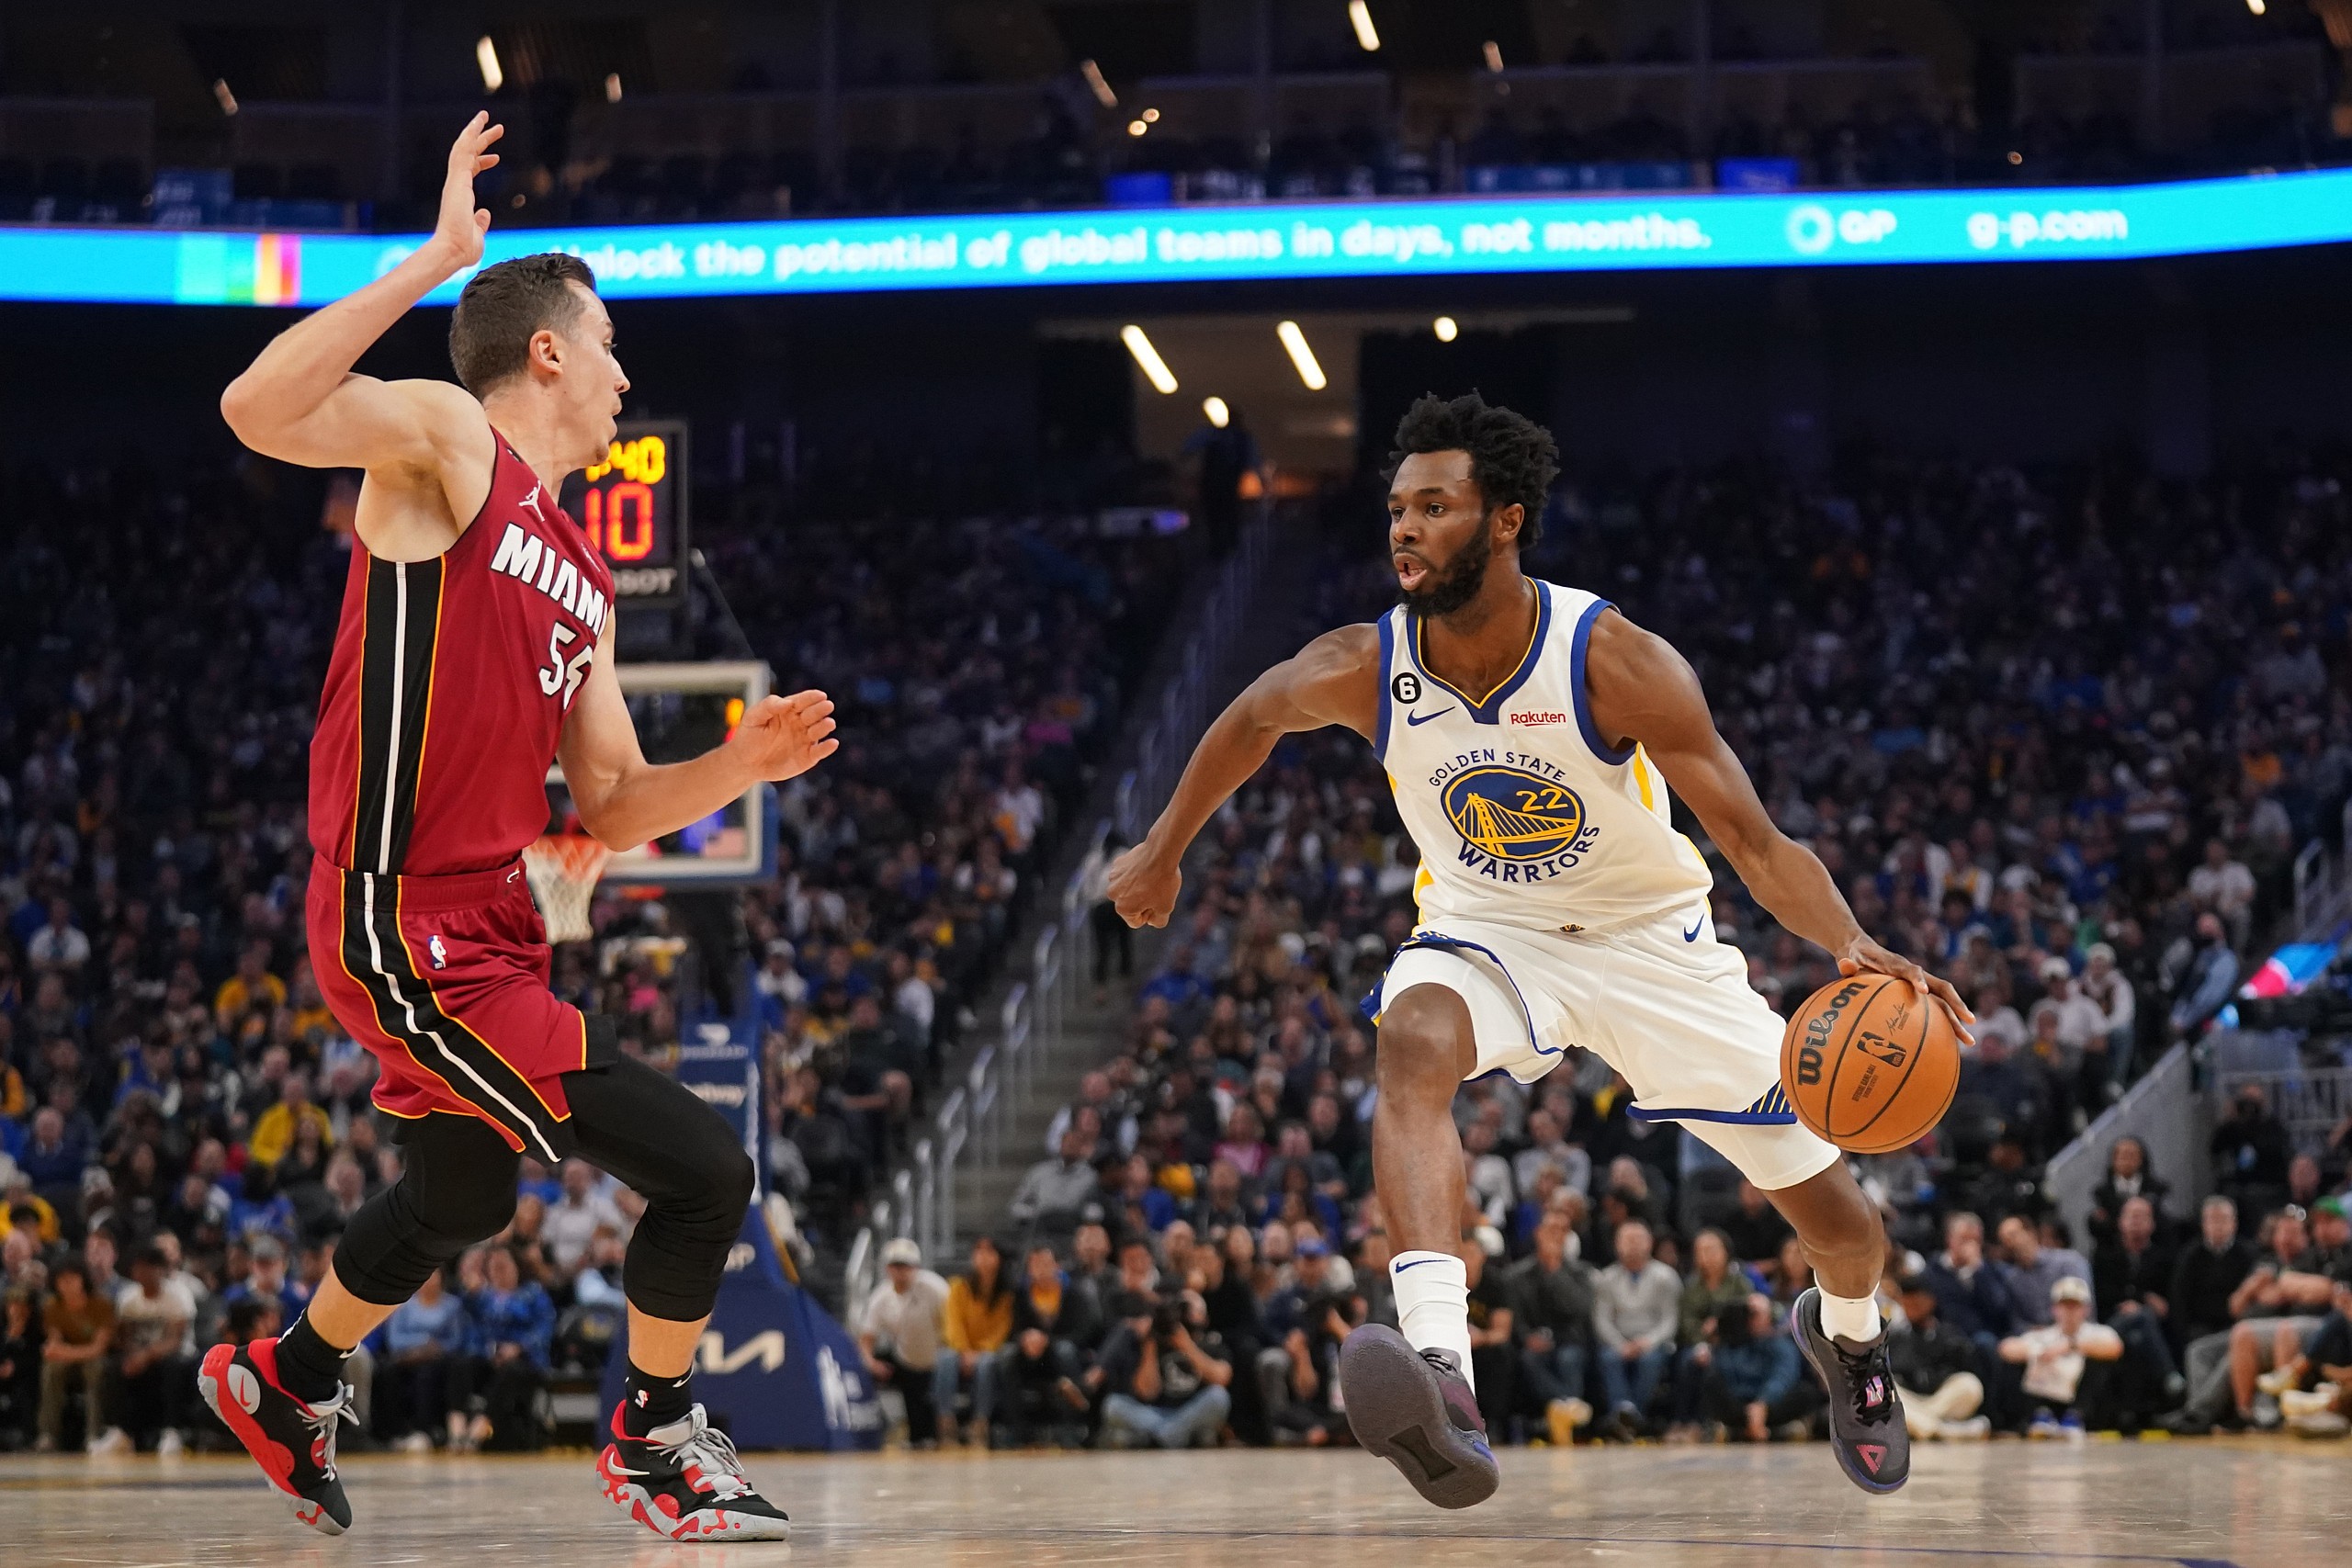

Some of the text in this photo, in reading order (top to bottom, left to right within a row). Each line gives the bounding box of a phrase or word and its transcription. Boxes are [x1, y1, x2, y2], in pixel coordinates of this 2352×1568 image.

[550, 211, 1712, 282] nlock the potential of global teams in days, not months.
[1398, 677, 1416, 700] 6
[1510, 710, 1566, 725] Rakuten
[1429, 749, 1566, 787] GOLDEN STATE
[1516, 788, 1568, 812] 22
[1457, 826, 1600, 883] WARRIORS
[1797, 982, 1869, 1086] Wilson
